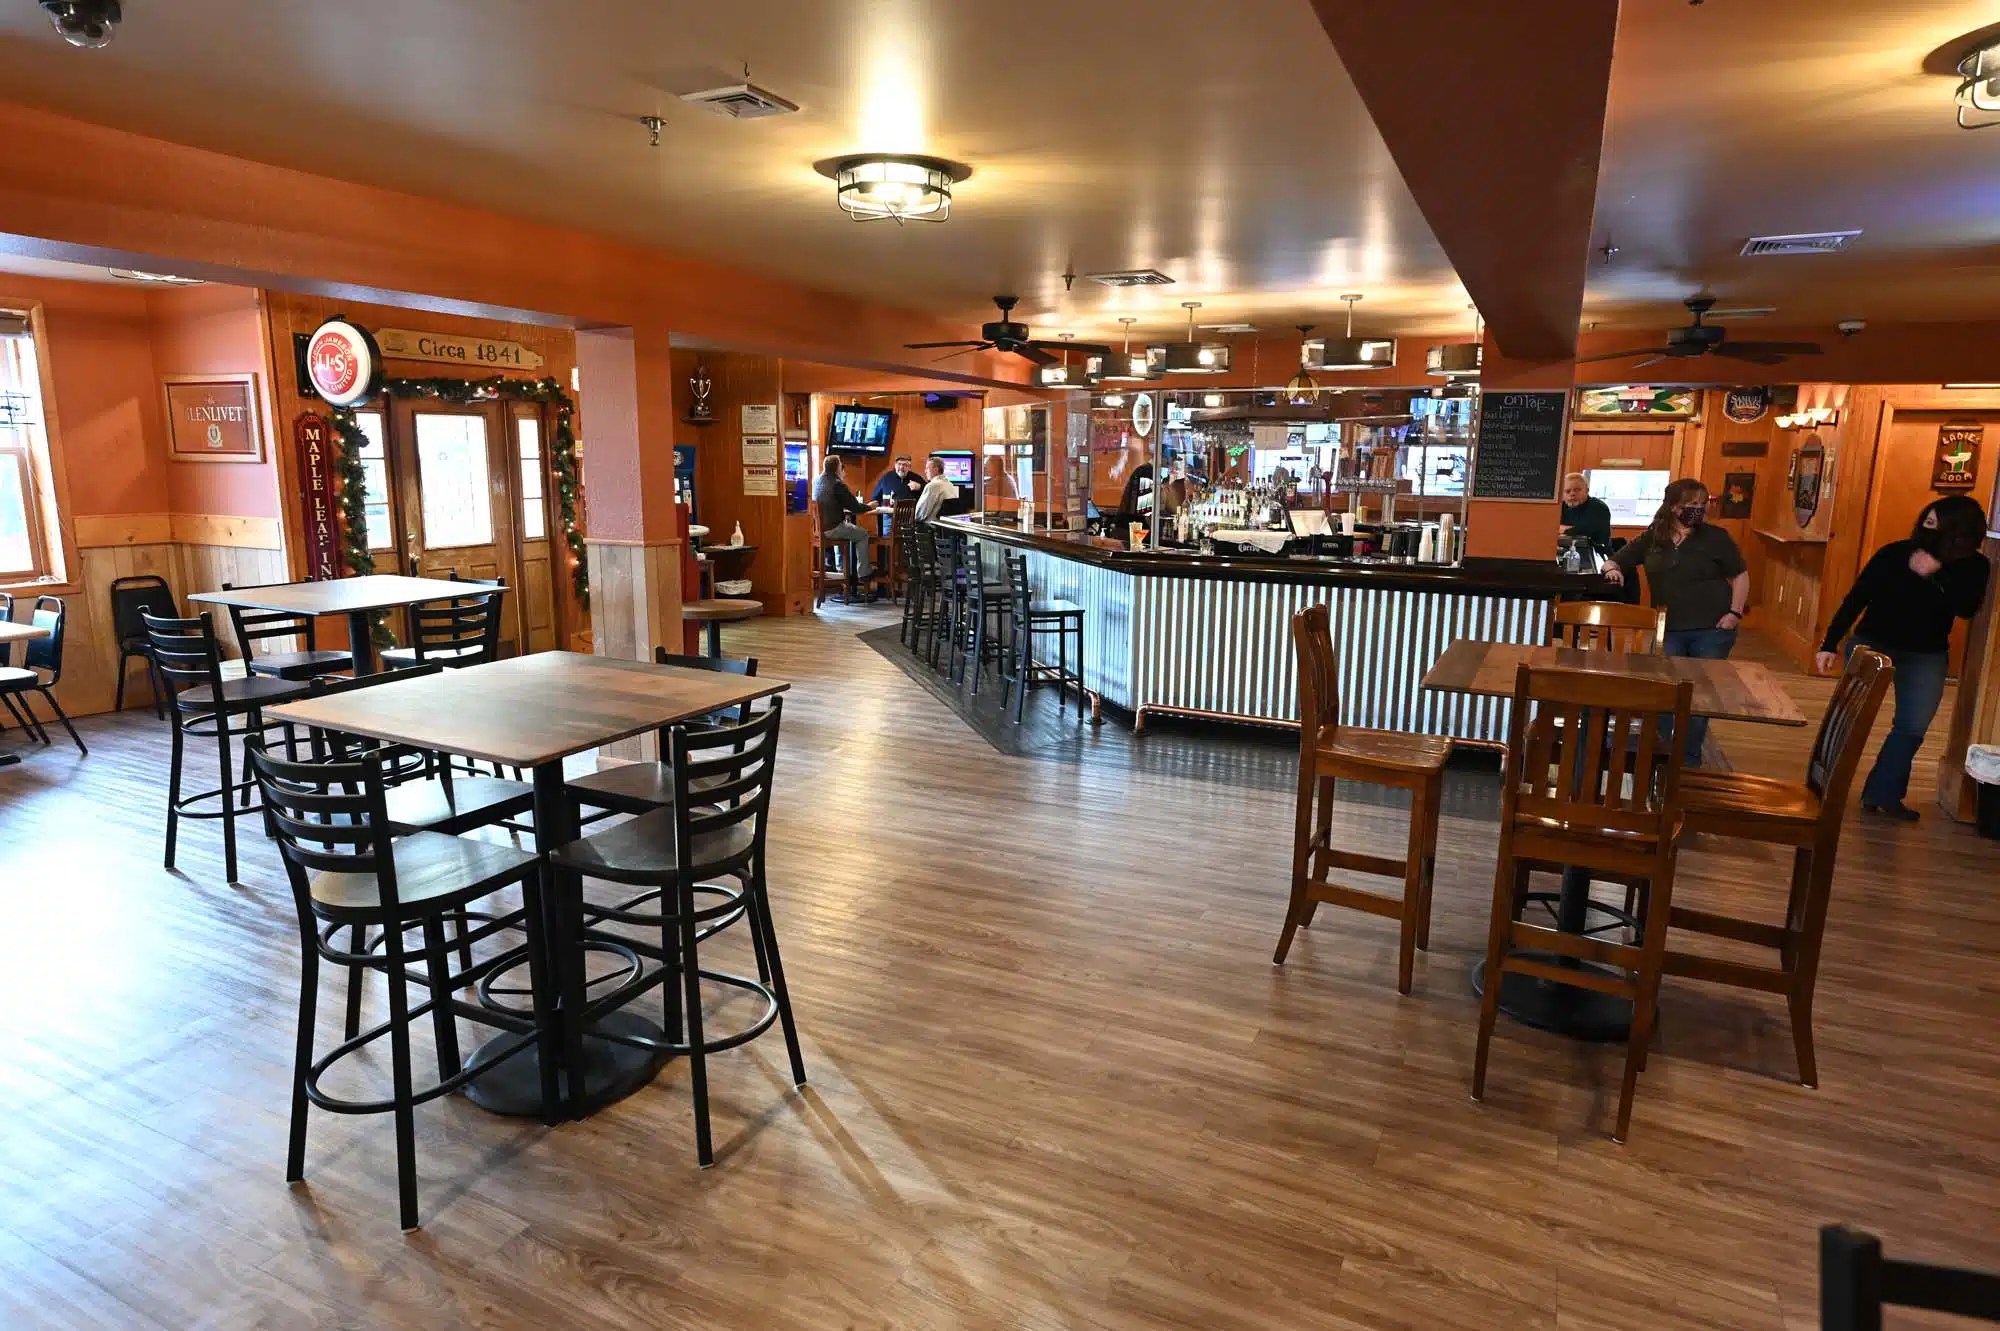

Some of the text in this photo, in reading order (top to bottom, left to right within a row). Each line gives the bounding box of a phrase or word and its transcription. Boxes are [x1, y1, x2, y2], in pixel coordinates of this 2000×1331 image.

[418, 337, 521, 364] Circa 1841
[331, 369, 353, 392] LIMITED
[305, 428, 323, 491] MAPLE
[1940, 472, 1973, 482] ROOM
